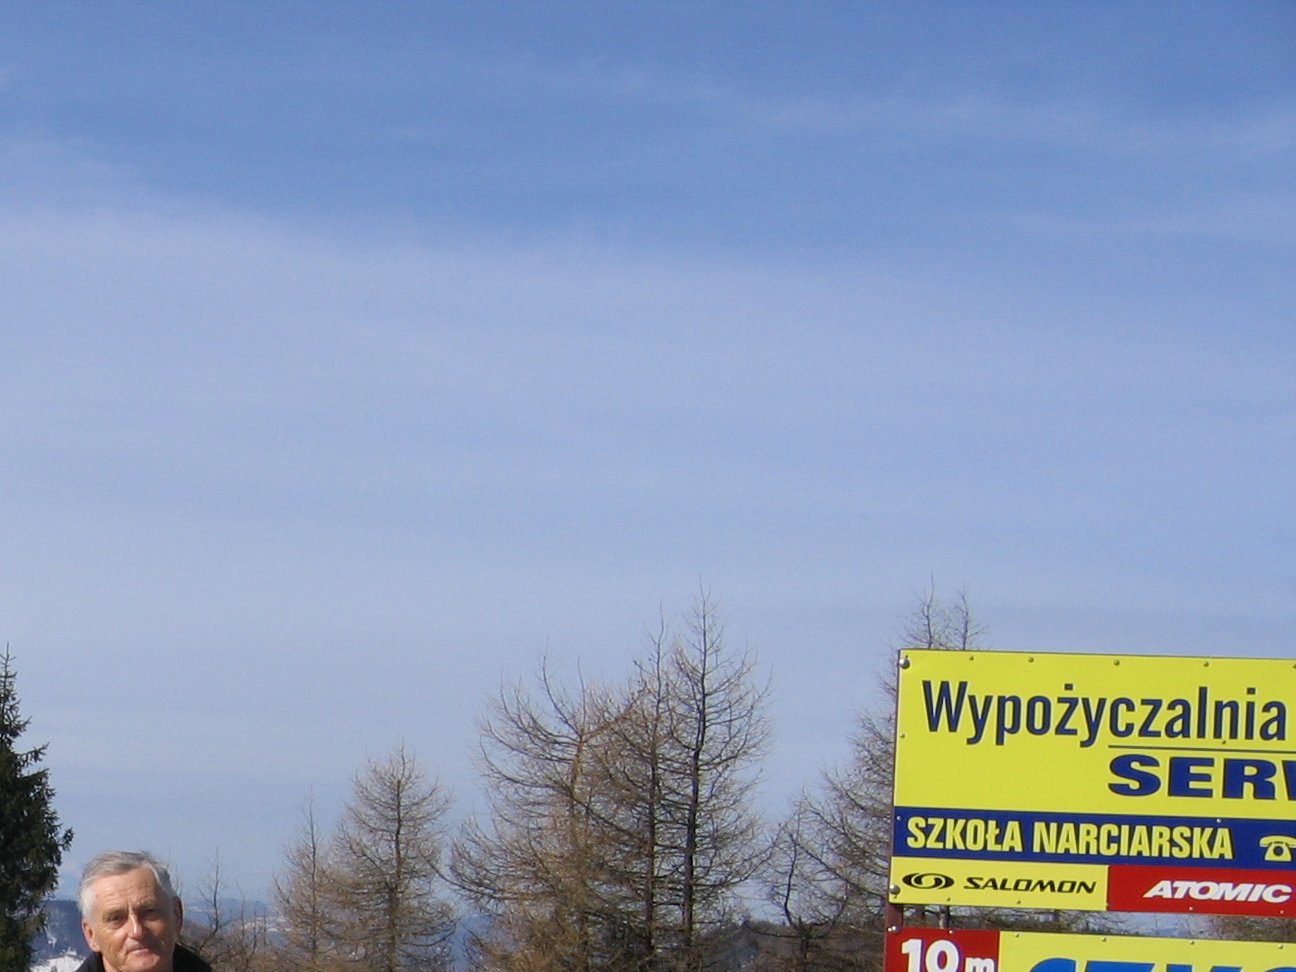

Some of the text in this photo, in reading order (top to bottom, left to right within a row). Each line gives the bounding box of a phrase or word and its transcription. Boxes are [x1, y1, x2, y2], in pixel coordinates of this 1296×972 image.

[921, 680, 1287, 748] Wypożyczalnia
[1108, 754, 1296, 801] SER
[906, 817, 1234, 860] SZKOŁA NARCIARSKA
[963, 876, 1097, 894] SALOMON
[1143, 880, 1293, 904] ATOMIC
